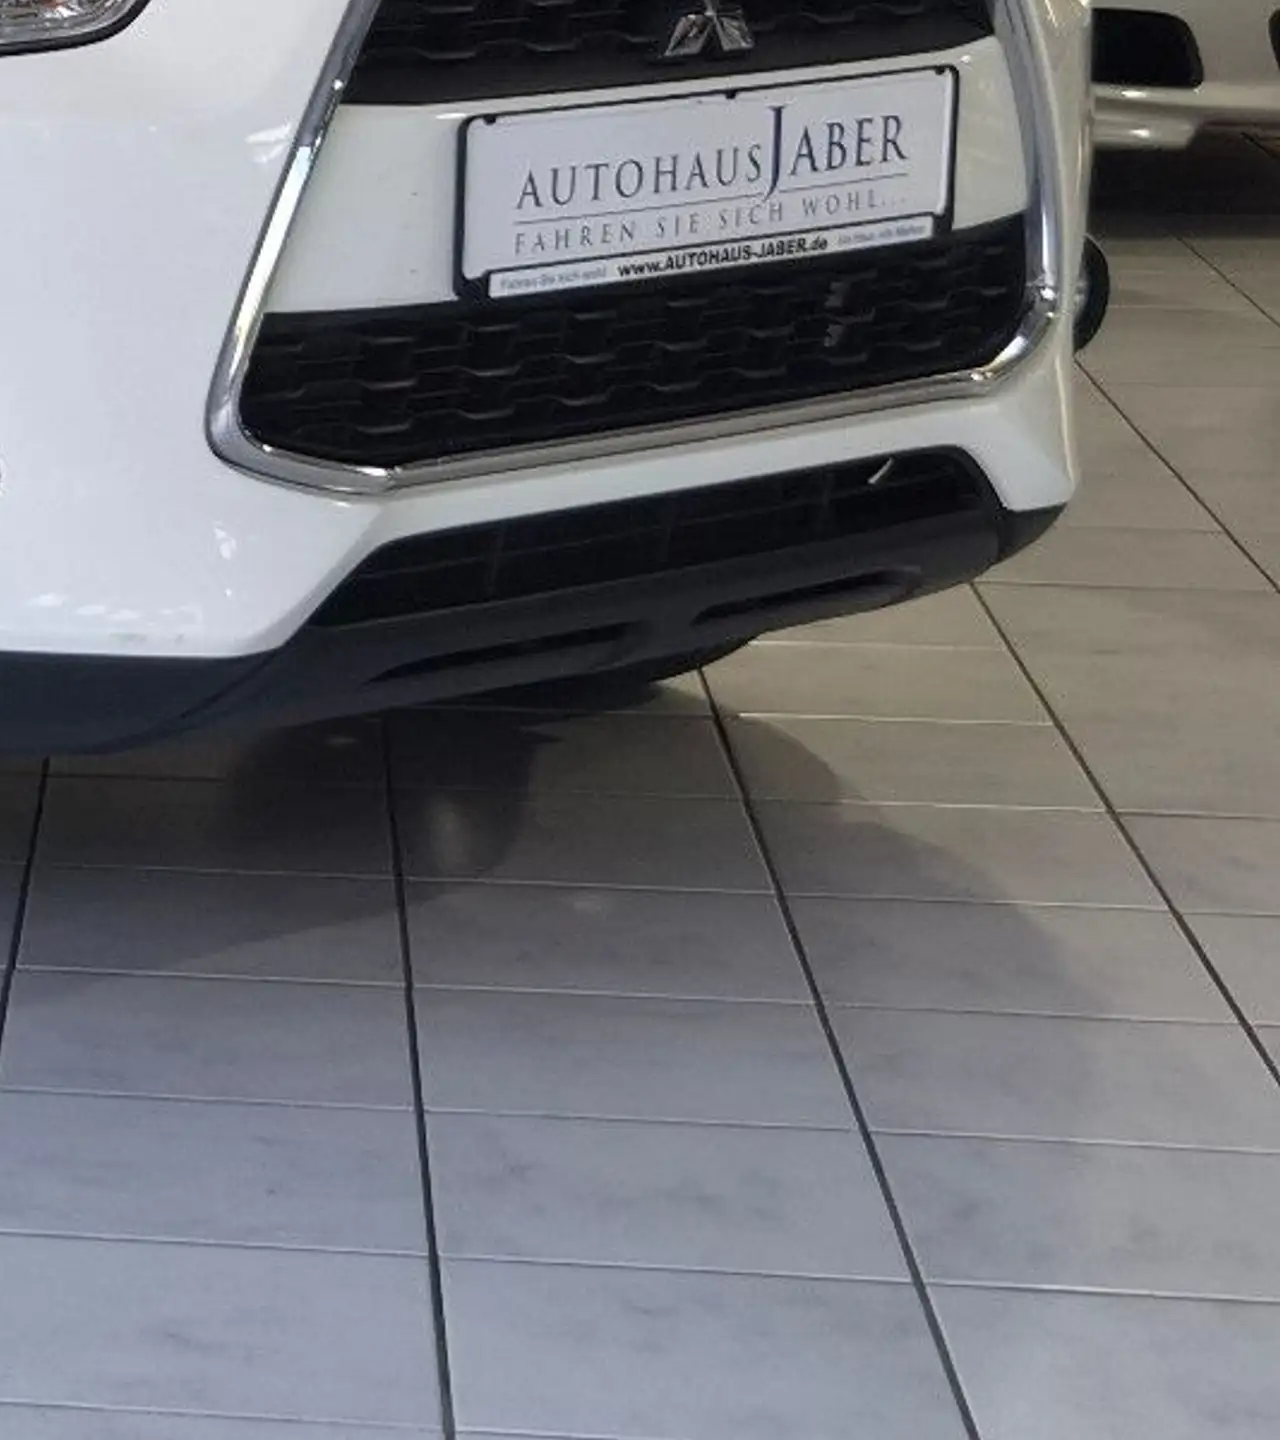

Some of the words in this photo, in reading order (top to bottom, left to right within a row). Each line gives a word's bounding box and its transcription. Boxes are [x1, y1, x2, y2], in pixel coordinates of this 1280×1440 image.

[514, 220, 637, 256] FAHREN
[656, 212, 700, 238] SIE
[718, 202, 783, 229] SICH
[617, 236, 829, 278] www.AUTOHAUS-JABER.de
